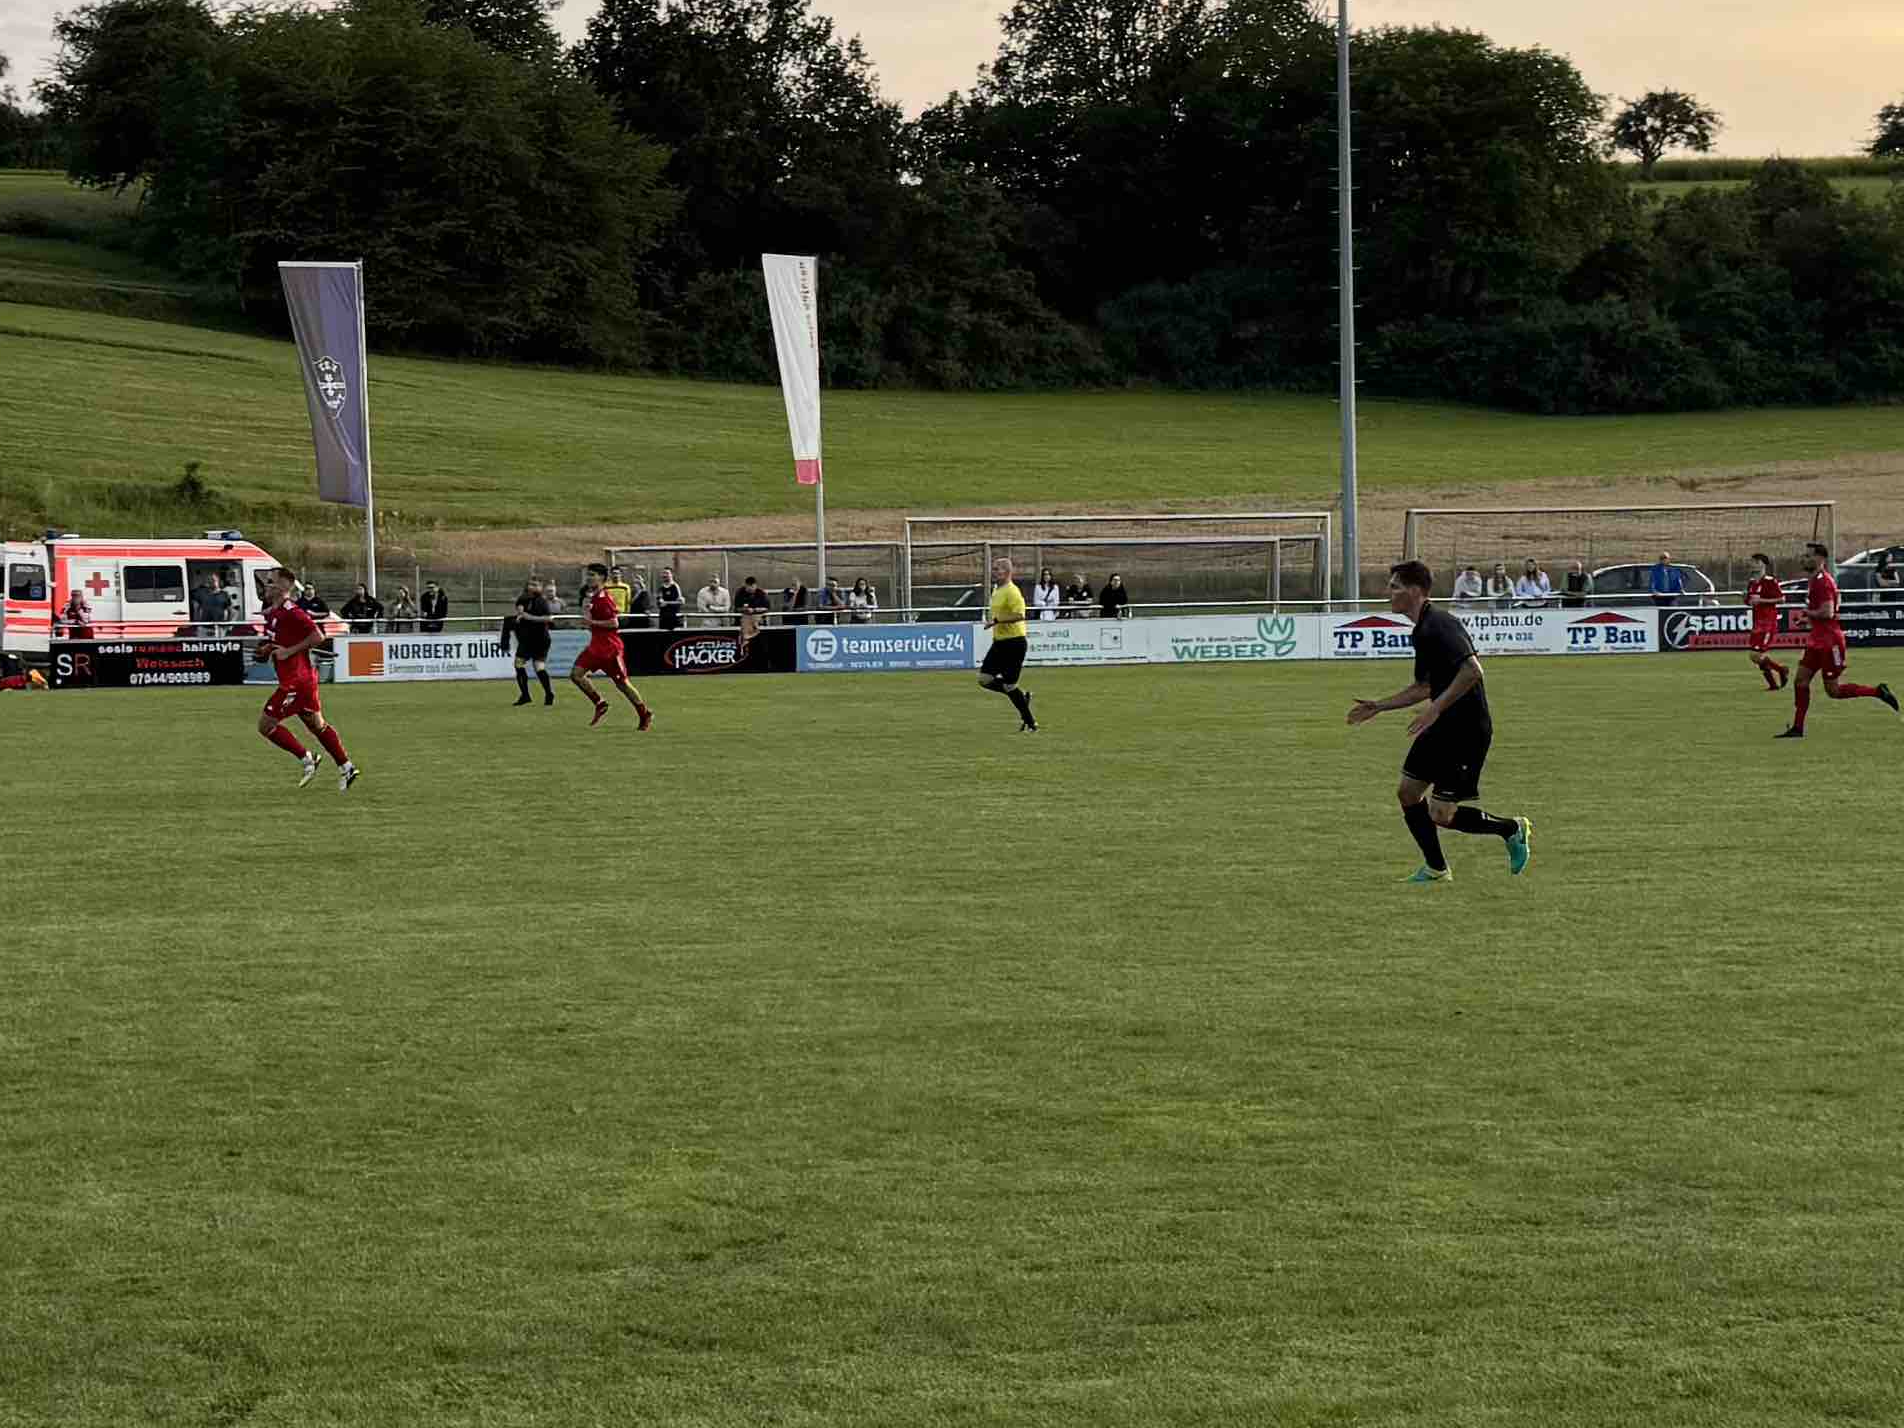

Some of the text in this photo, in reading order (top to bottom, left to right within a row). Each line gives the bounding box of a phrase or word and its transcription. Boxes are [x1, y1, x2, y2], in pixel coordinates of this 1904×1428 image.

[1458, 613, 1543, 630] w.tpbau.de
[842, 633, 964, 655] teamservice24
[1334, 629, 1415, 649] TP Bau
[1567, 626, 1647, 645] TP Bau
[388, 643, 461, 660] NORBERT
[1171, 642, 1267, 660] WEBER
